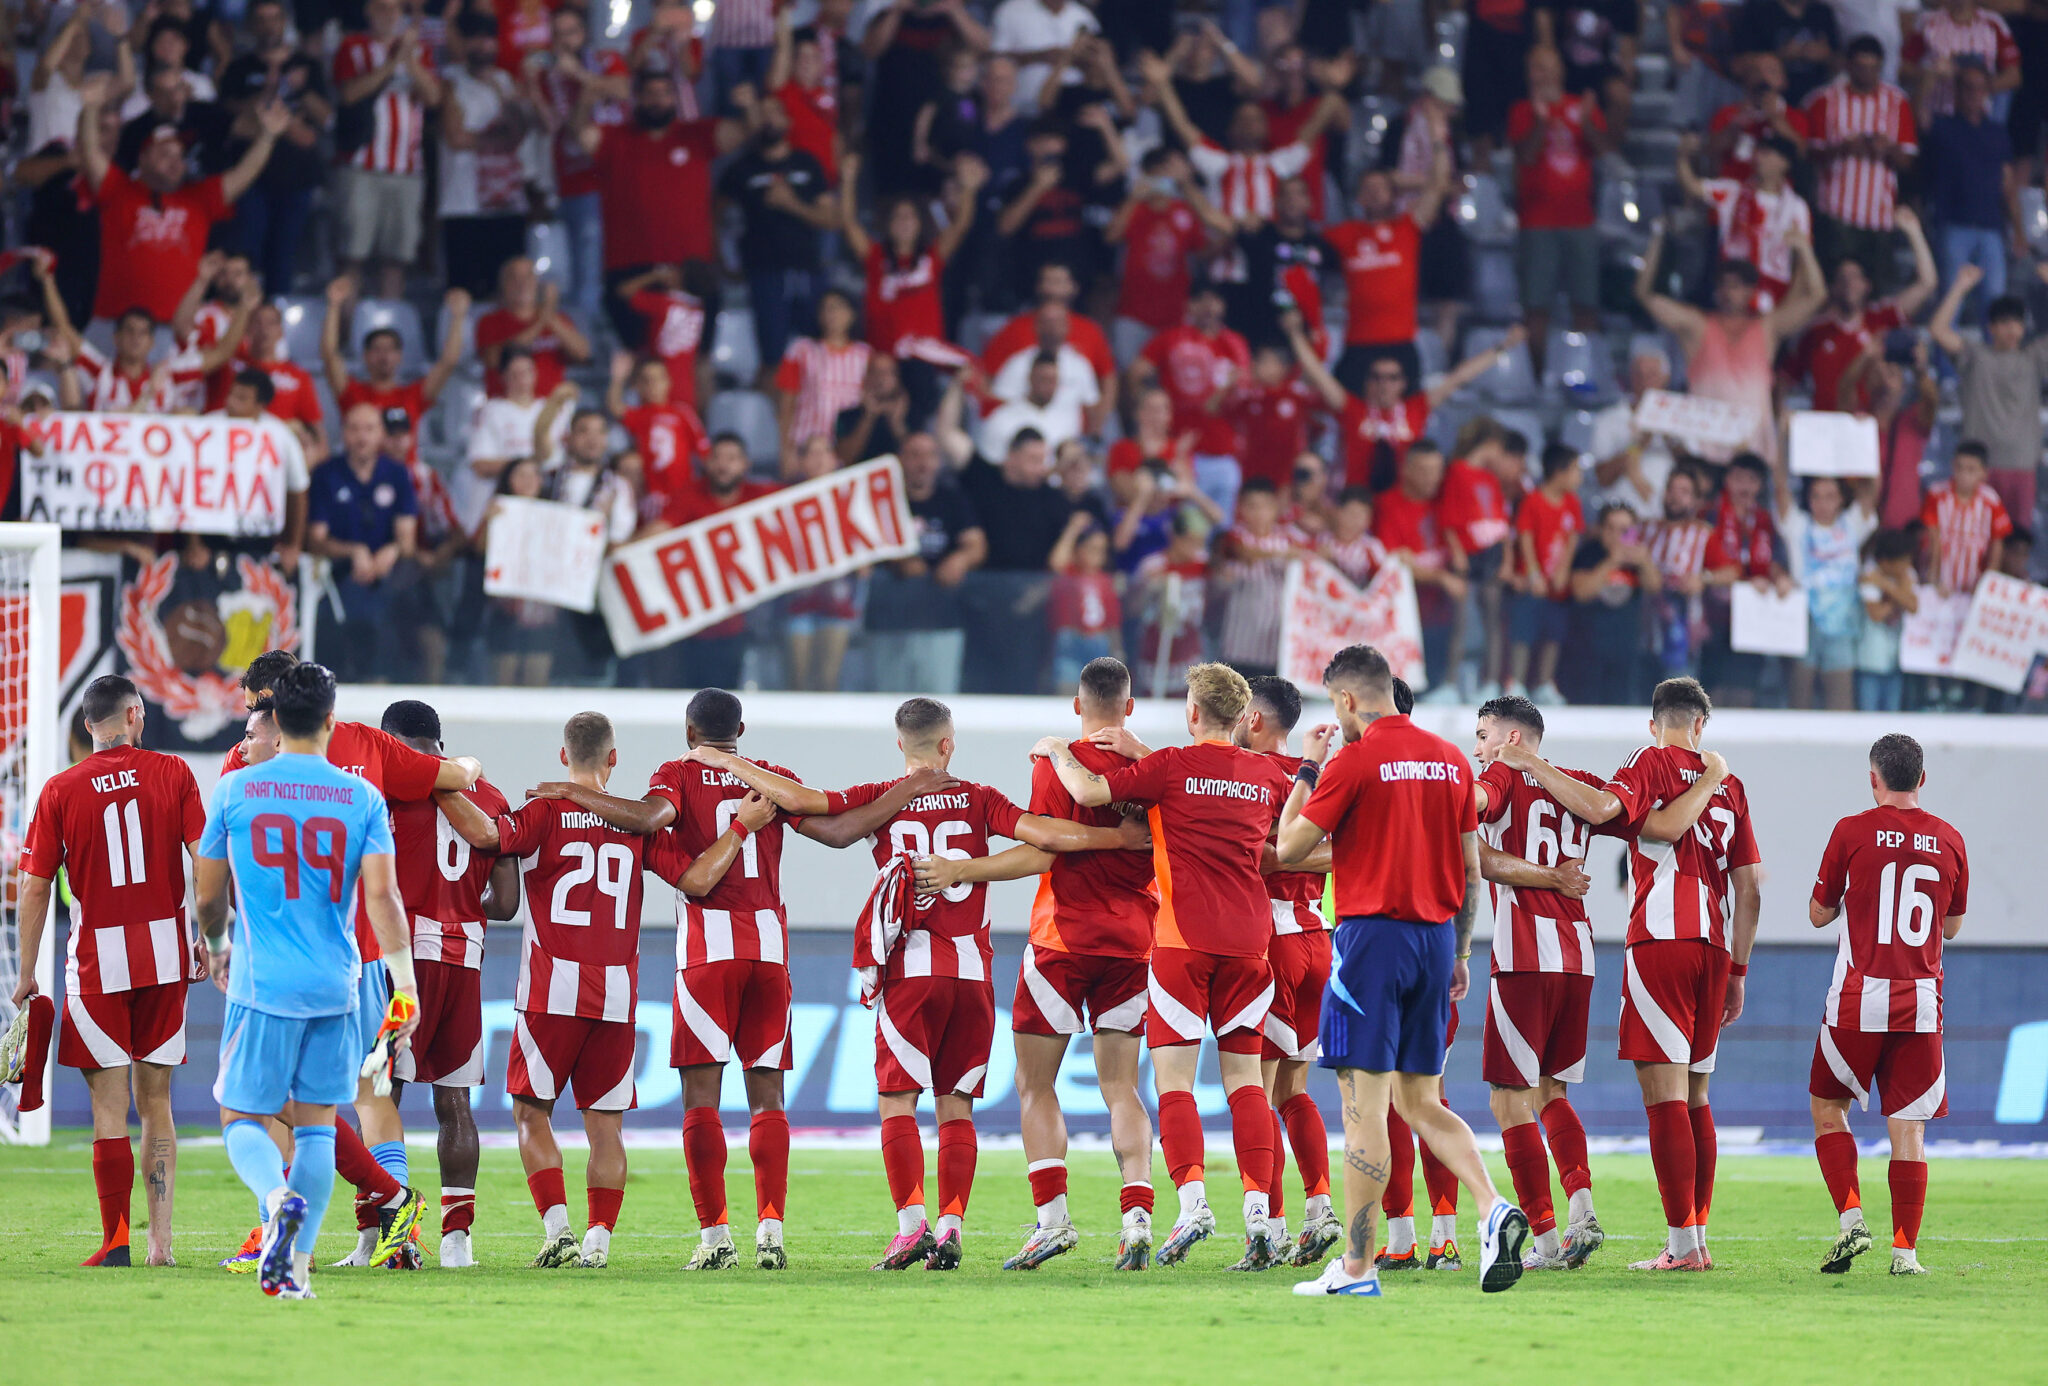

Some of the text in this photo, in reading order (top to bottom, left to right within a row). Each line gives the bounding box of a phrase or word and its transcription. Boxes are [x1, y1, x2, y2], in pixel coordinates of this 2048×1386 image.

[613, 468, 904, 634] LARNAKA
[91, 769, 140, 794] VELDE
[701, 769, 720, 786] EL
[1185, 776, 1271, 806] OLYMPIACOS FC
[1379, 760, 1460, 785] OLYMPIACOS FC
[103, 798, 146, 888] 11
[250, 812, 347, 904] 99
[1876, 830, 1942, 854] PEP BIEL
[551, 841, 634, 930] 29
[1877, 861, 1940, 947] 16
